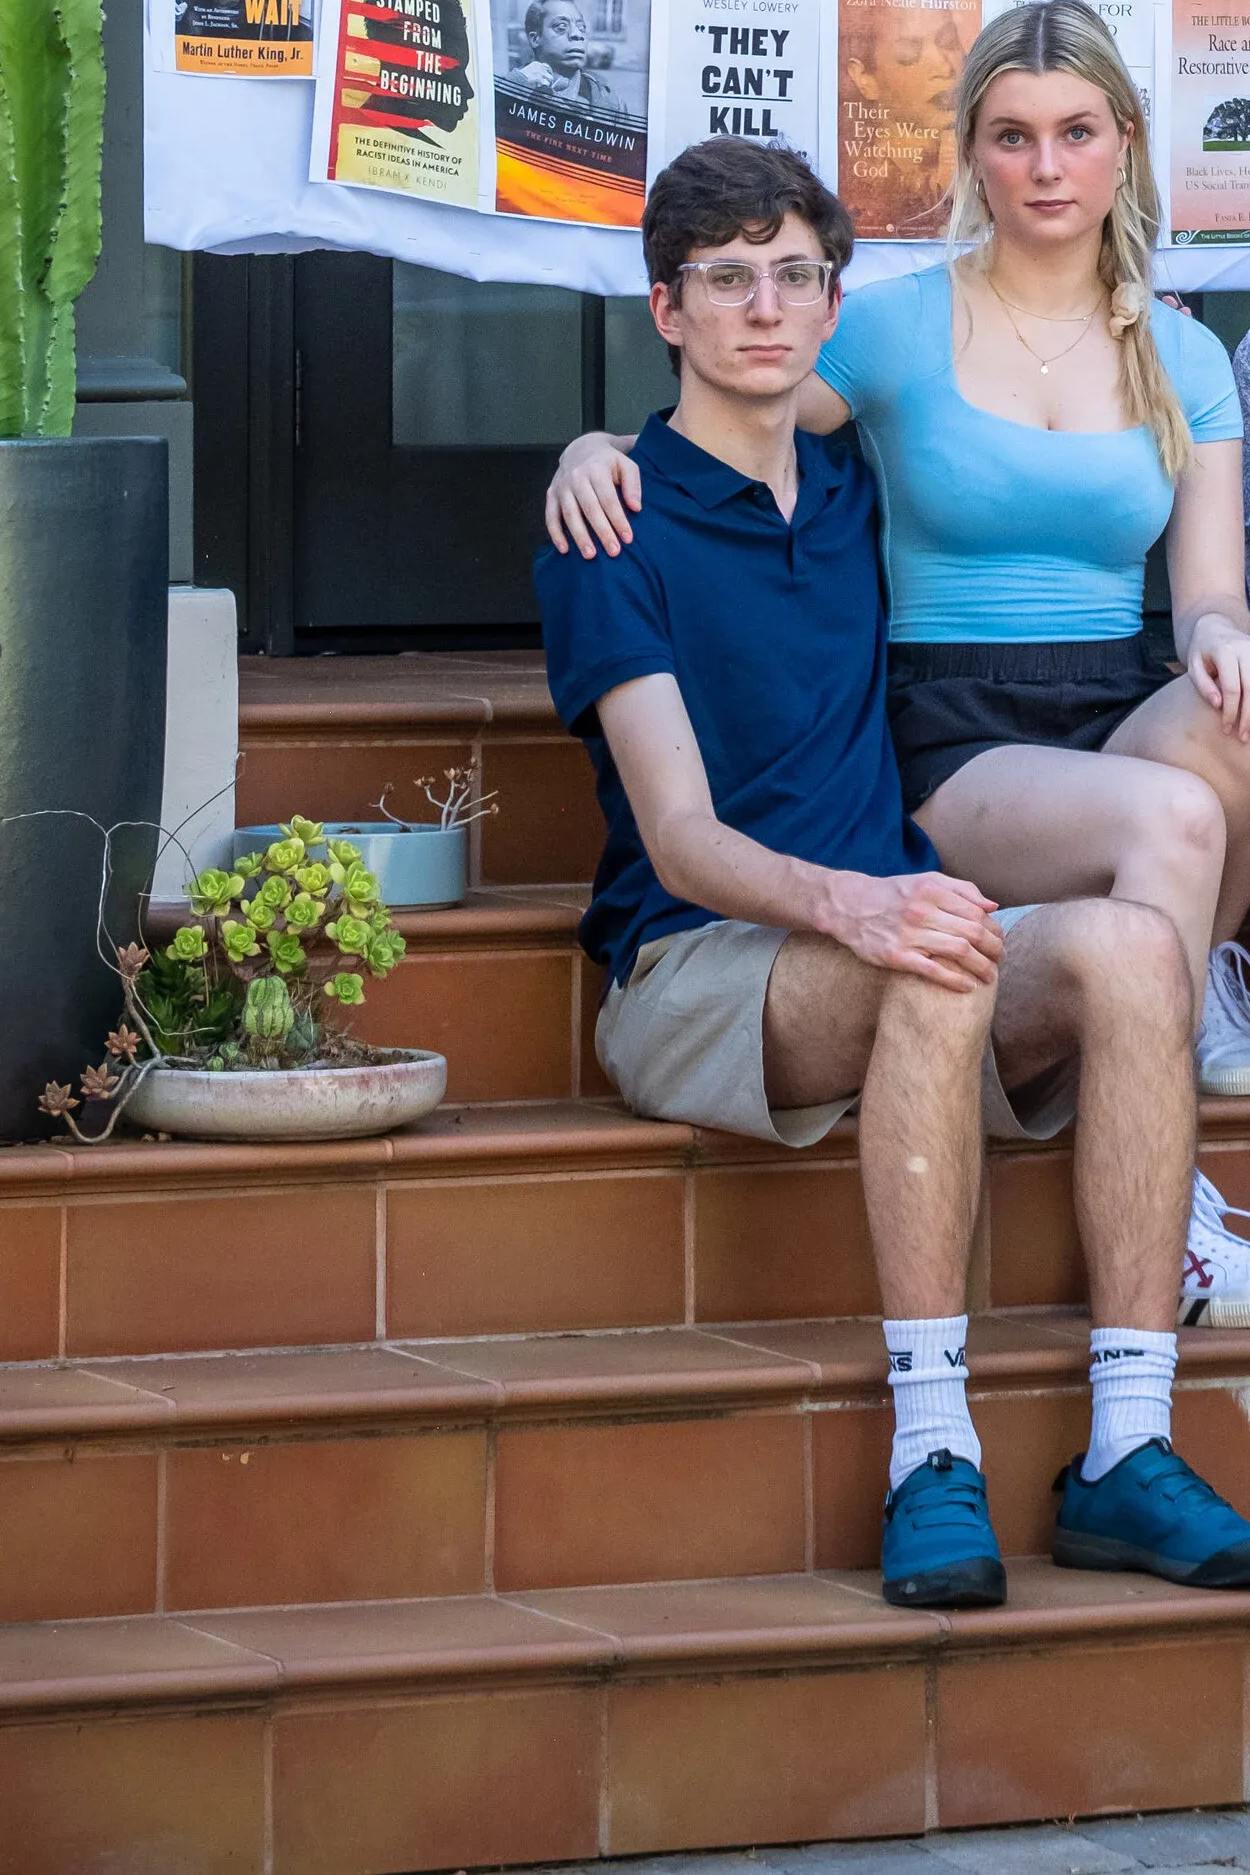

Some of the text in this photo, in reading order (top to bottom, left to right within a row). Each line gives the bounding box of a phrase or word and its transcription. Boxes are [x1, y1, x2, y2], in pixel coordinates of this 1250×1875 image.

[1192, 16, 1209, 26] THE
[1211, 16, 1239, 26] LITTLE
[403, 21, 442, 49] FROM
[1208, 34, 1237, 52] Race
[182, 41, 303, 63] Martin Luther King, Jr.
[416, 50, 442, 75] THE
[1178, 57, 1249, 75] Restorative
[380, 70, 461, 106] BEGINNING
[701, 65, 793, 97] CAN'T
[710, 106, 778, 137] KILL
[844, 102, 890, 120] Their
[509, 102, 636, 151] JAMES BALDWIN
[854, 122, 939, 143] Eyes Were
[355, 137, 462, 165] THE DEFINITIVE HISTORY OF
[356, 149, 386, 161] RACIST
[388, 154, 410, 166] IDEAS
[422, 162, 460, 176] AMERICA
[845, 141, 923, 163] Watching
[853, 160, 888, 178] God
